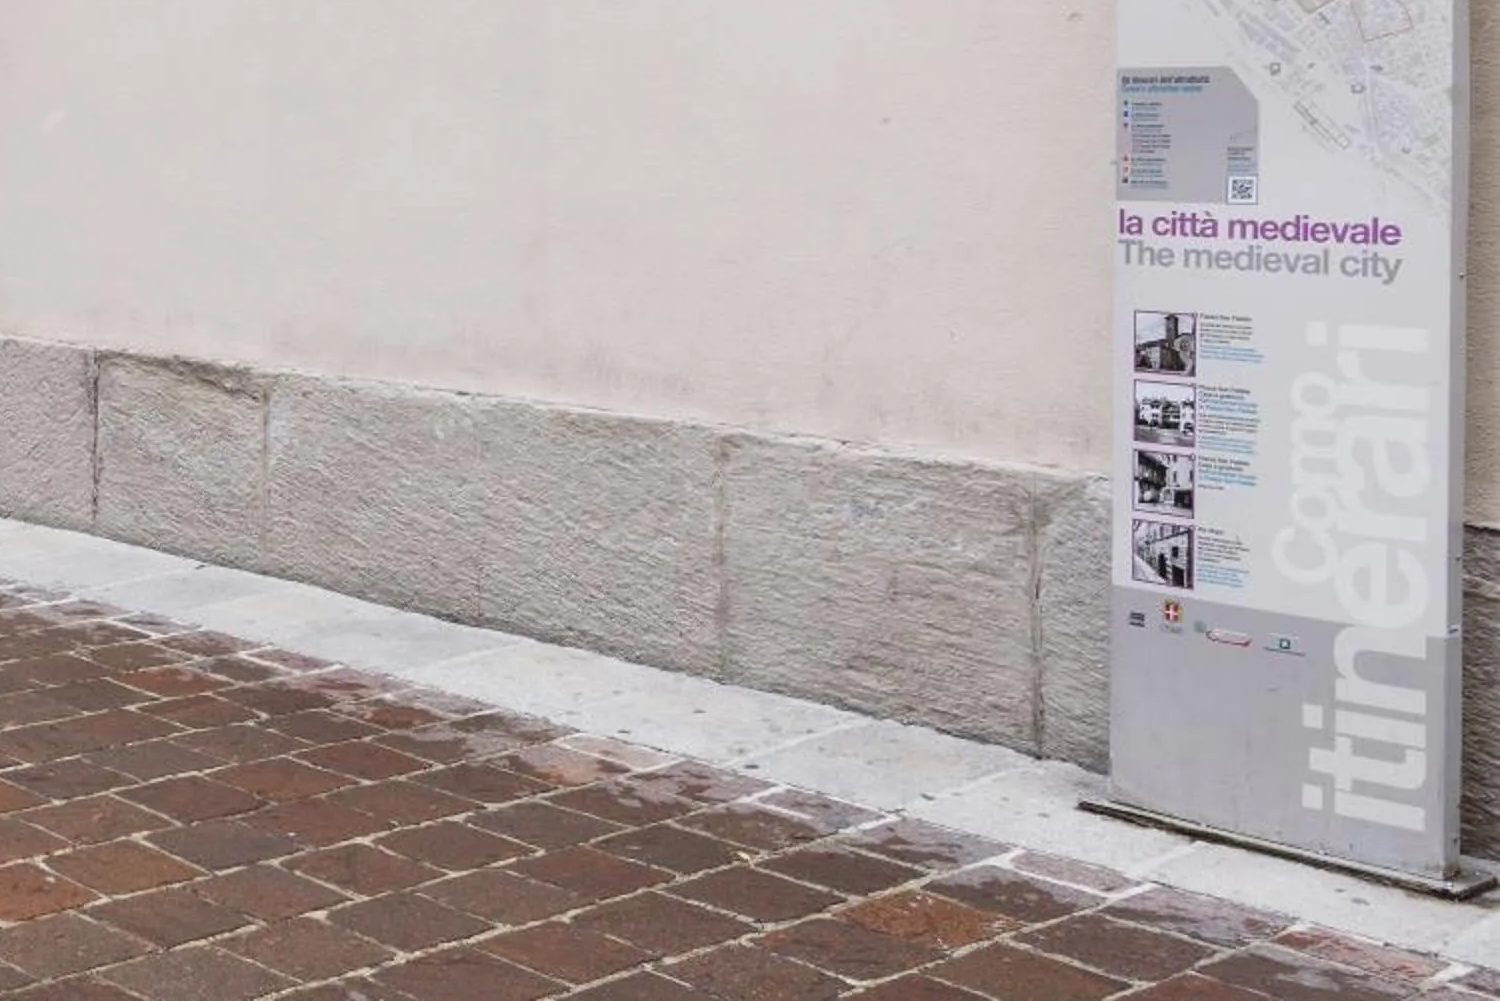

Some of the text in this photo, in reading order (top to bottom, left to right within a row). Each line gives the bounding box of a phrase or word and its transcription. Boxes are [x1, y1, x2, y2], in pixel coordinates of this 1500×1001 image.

[1118, 208, 1403, 246] la città medievale
[1118, 239, 1404, 285] The medieval city
[1271, 370, 1338, 583] Como
[1302, 320, 1431, 833] itinerari
